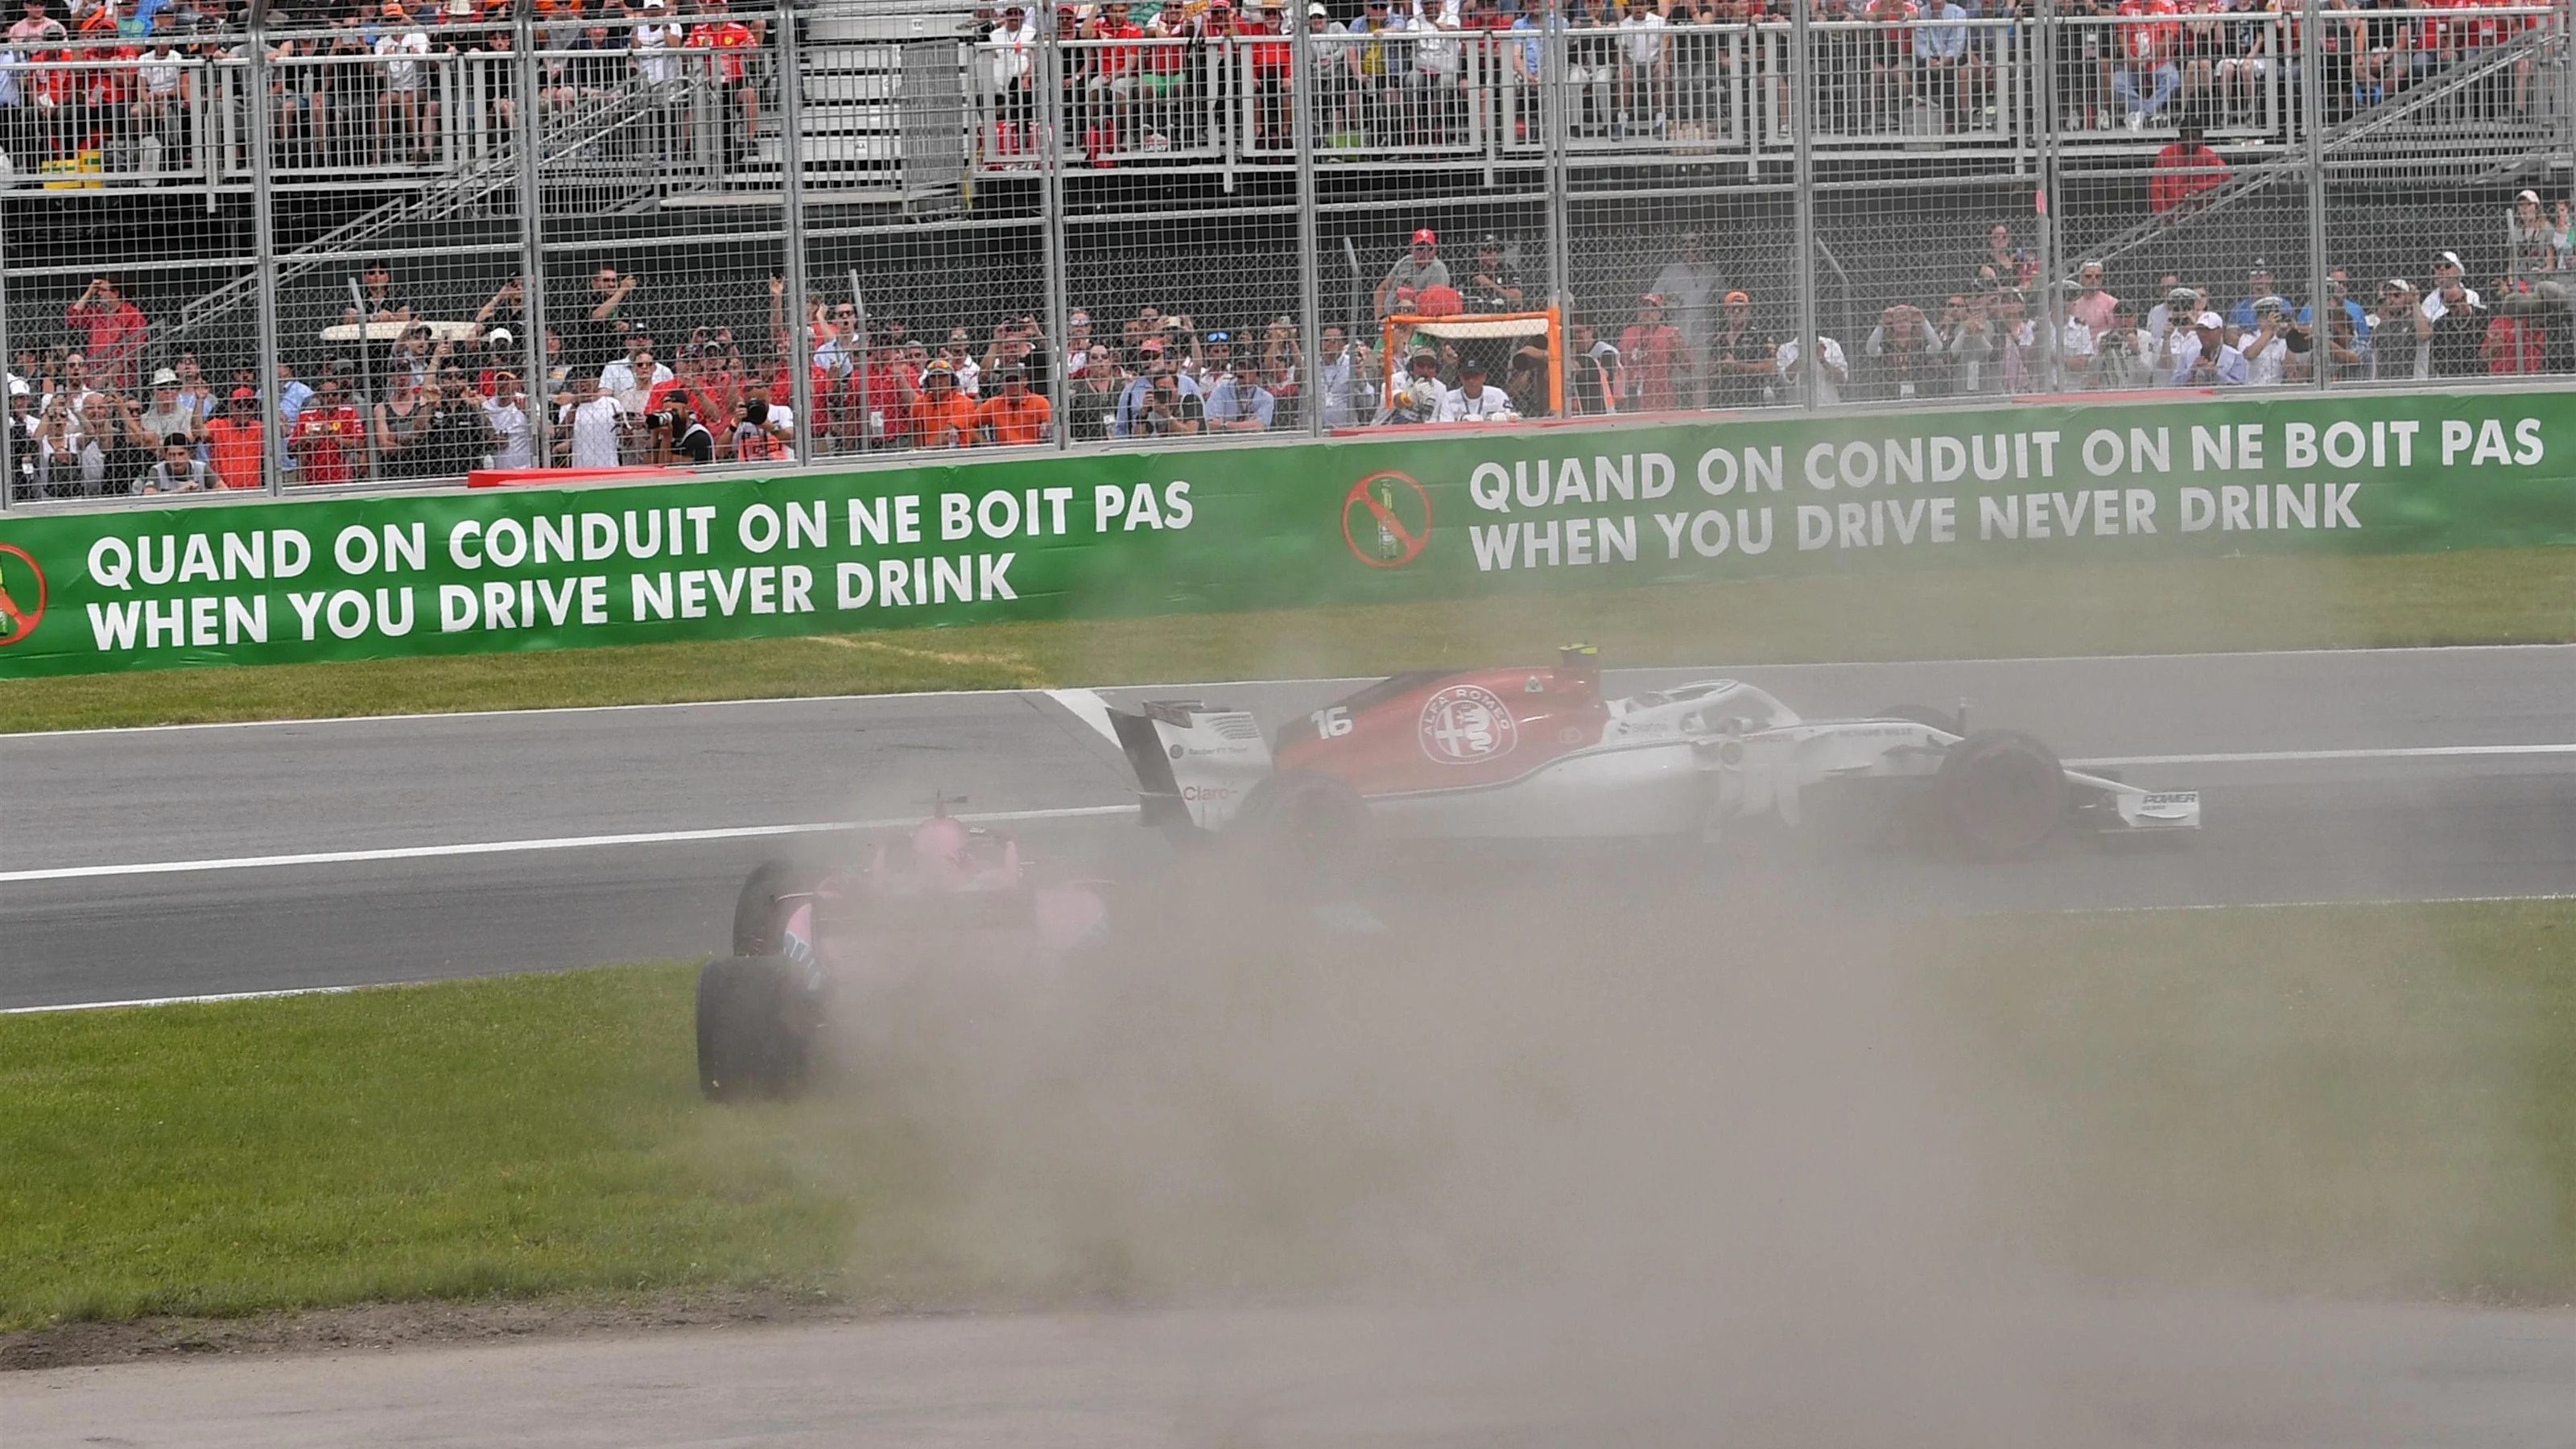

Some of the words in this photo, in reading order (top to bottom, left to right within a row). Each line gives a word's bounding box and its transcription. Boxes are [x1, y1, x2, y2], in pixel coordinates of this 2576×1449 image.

[1470, 455, 1675, 513] QUAND
[1698, 446, 1782, 495] ON
[1805, 431, 2059, 489] CONDUIT
[2083, 427, 2169, 476] ON
[2191, 424, 2263, 471] NE
[2285, 420, 2419, 469] BOIT
[2442, 418, 2544, 465] PAS
[88, 531, 311, 590] QUAND
[335, 522, 425, 574] ON
[449, 506, 716, 569] CONDUIT
[739, 501, 827, 552] ON
[848, 495, 920, 545] NE
[941, 485, 1072, 539] BOIT
[1095, 481, 1193, 532] PAS
[1469, 516, 1637, 571] WHEN
[1654, 507, 1772, 561] YOU
[1798, 498, 1955, 550] DRIVE
[1979, 488, 2157, 539] NEVER
[2181, 483, 2362, 531] DRINK
[86, 595, 267, 650] WHEN
[287, 587, 414, 640] YOU
[440, 576, 608, 633] DRIVE
[631, 565, 815, 621] NEVER
[837, 553, 1018, 609] DRINK
[1311, 706, 1353, 739] 16
[1422, 696, 1451, 737] ALFA
[1455, 688, 1511, 730] ROMEO
[2142, 794, 2196, 803] POWER
